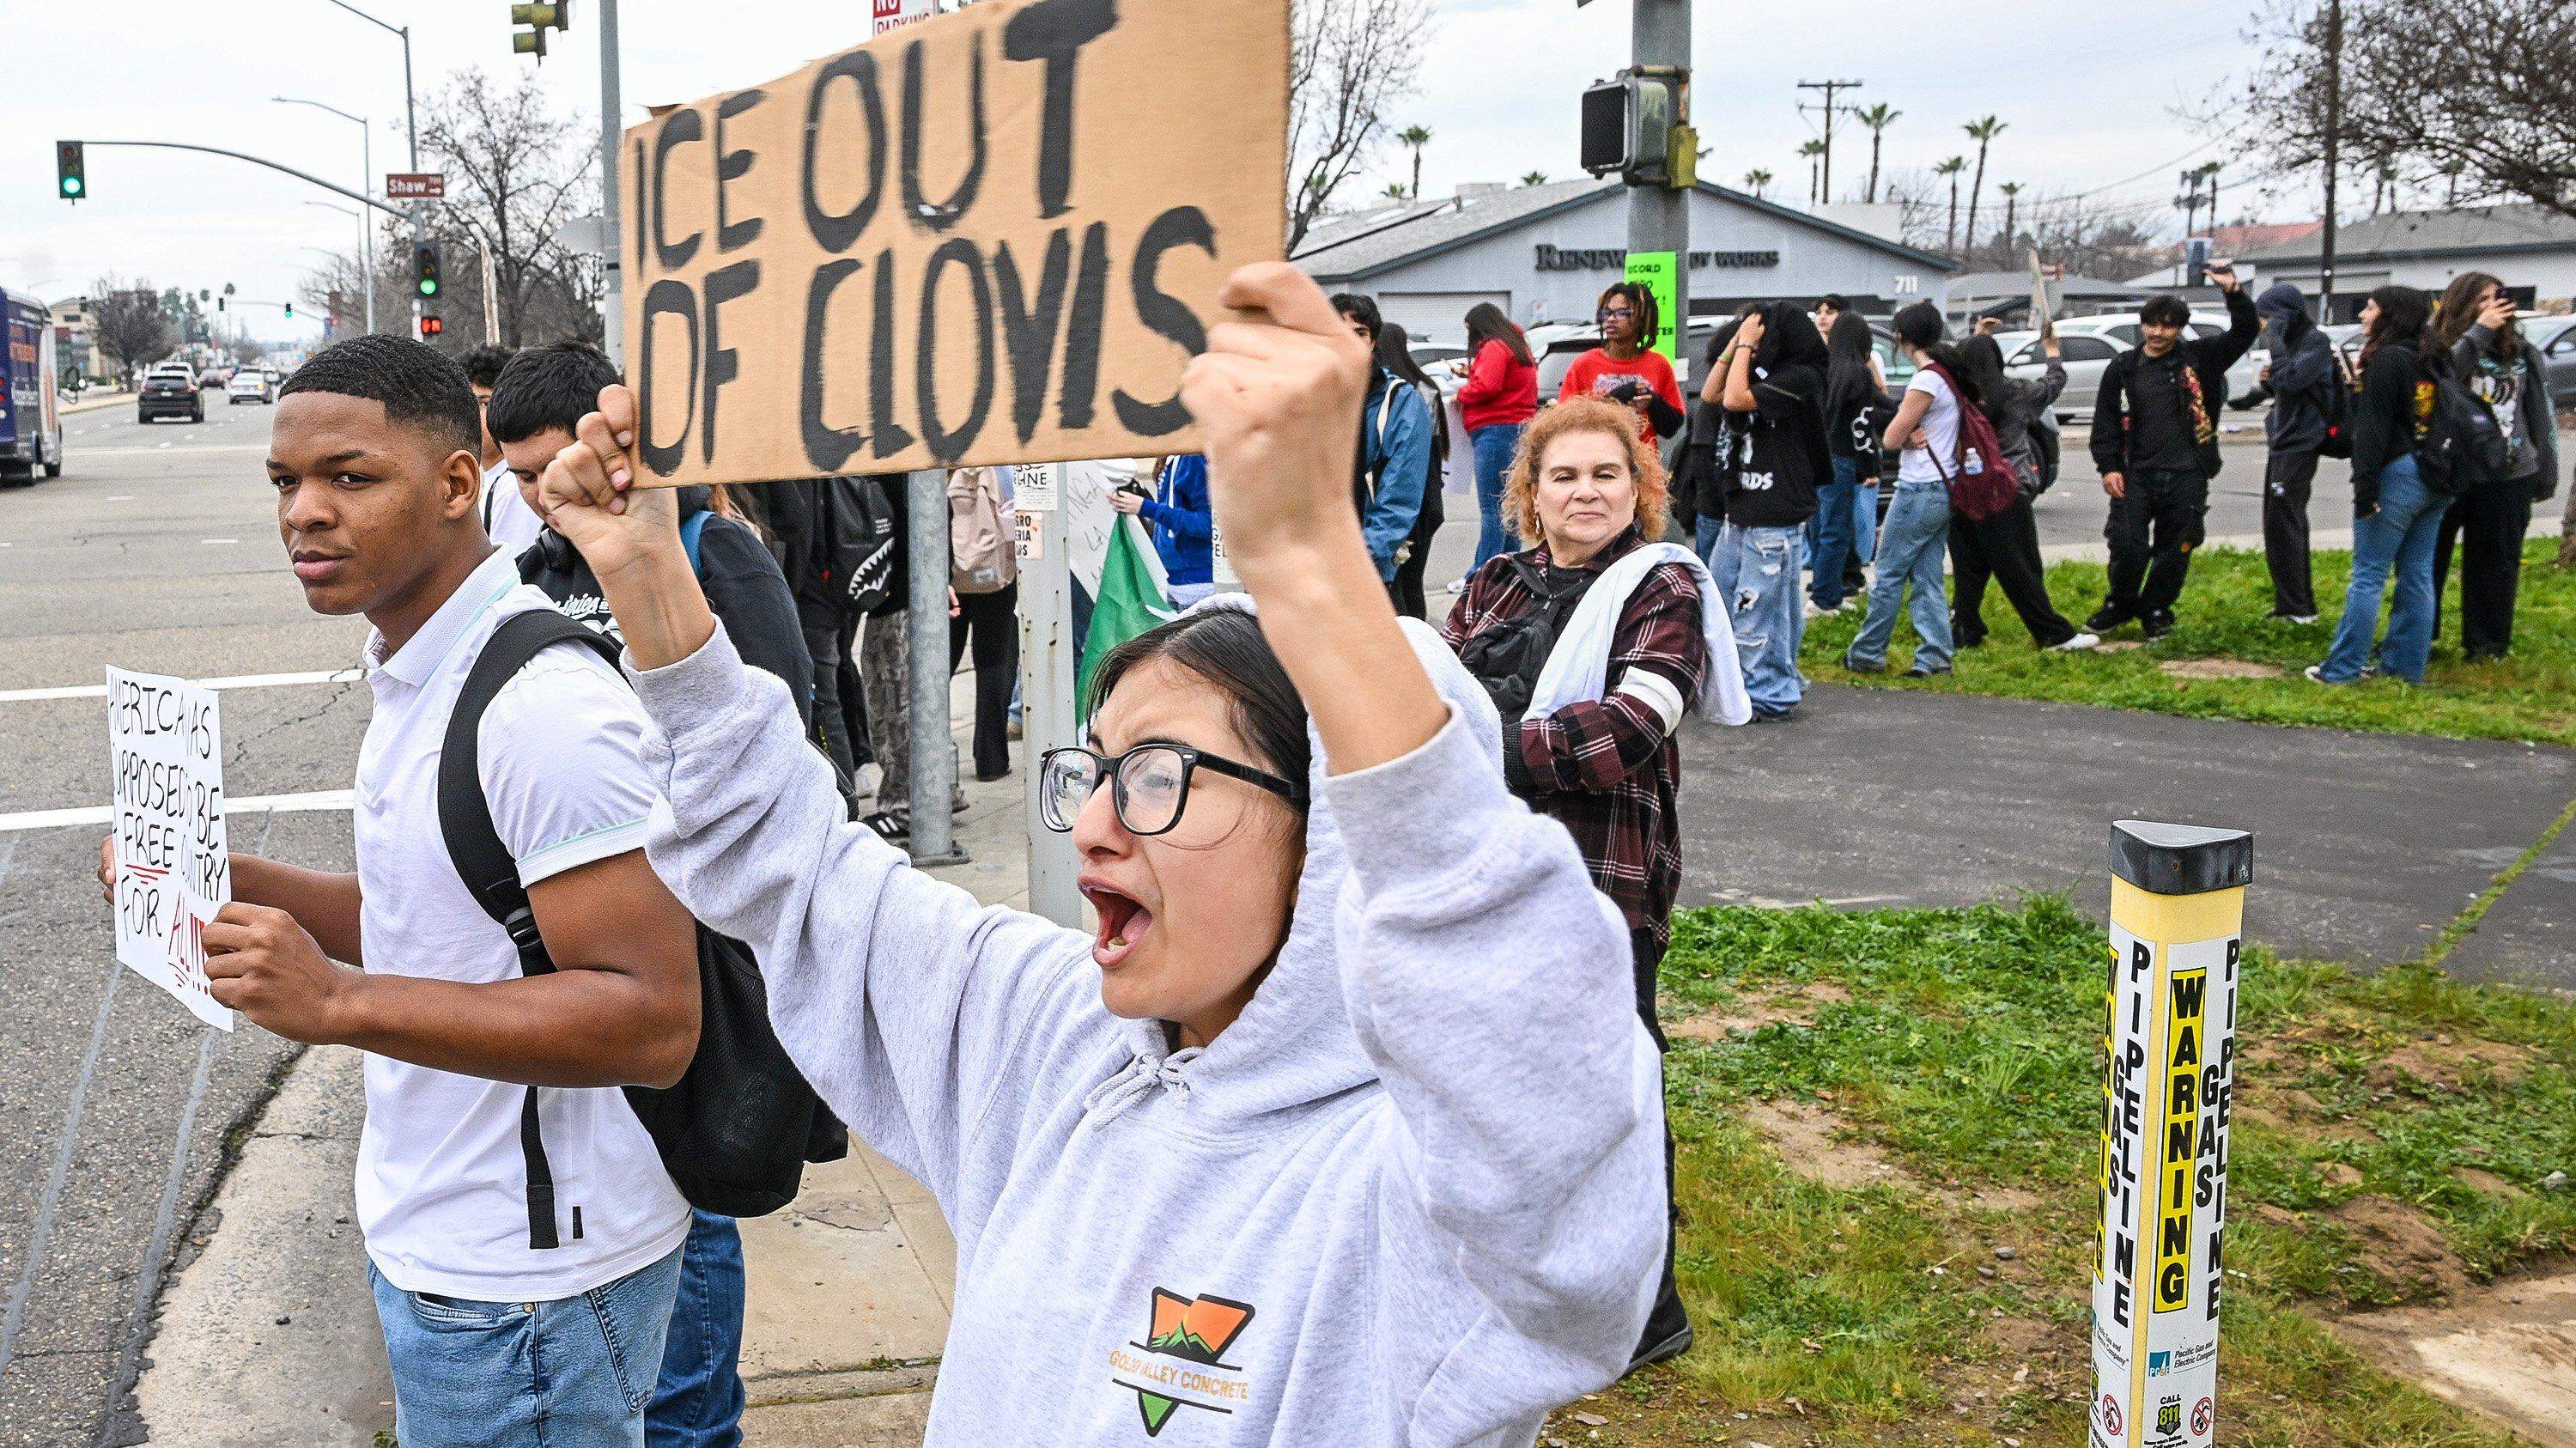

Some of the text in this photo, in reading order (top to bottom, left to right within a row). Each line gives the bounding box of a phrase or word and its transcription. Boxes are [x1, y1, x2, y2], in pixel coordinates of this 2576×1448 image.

[635, 0, 1121, 280] ICE OUT
[389, 179, 427, 193] Shaw
[1895, 275, 1917, 293] 711
[640, 206, 1219, 478] OF CLOVIS
[124, 812, 174, 868] FREE
[121, 873, 162, 943] FOR
[2109, 1054, 2125, 1198] GAS
[2113, 940, 2151, 1329] PIPELINE
[2160, 976, 2206, 1305] WARNING
[2195, 1064, 2220, 1208] GAS
[2173, 1354, 2196, 1368] Electric
[2174, 1346, 2195, 1360] Pacific
[2195, 1344, 2206, 1354] Gas
[1181, 1372, 1249, 1400] CONCRETE
[2160, 1393, 2182, 1405] CALL
[2159, 1406, 2179, 1427] 811
